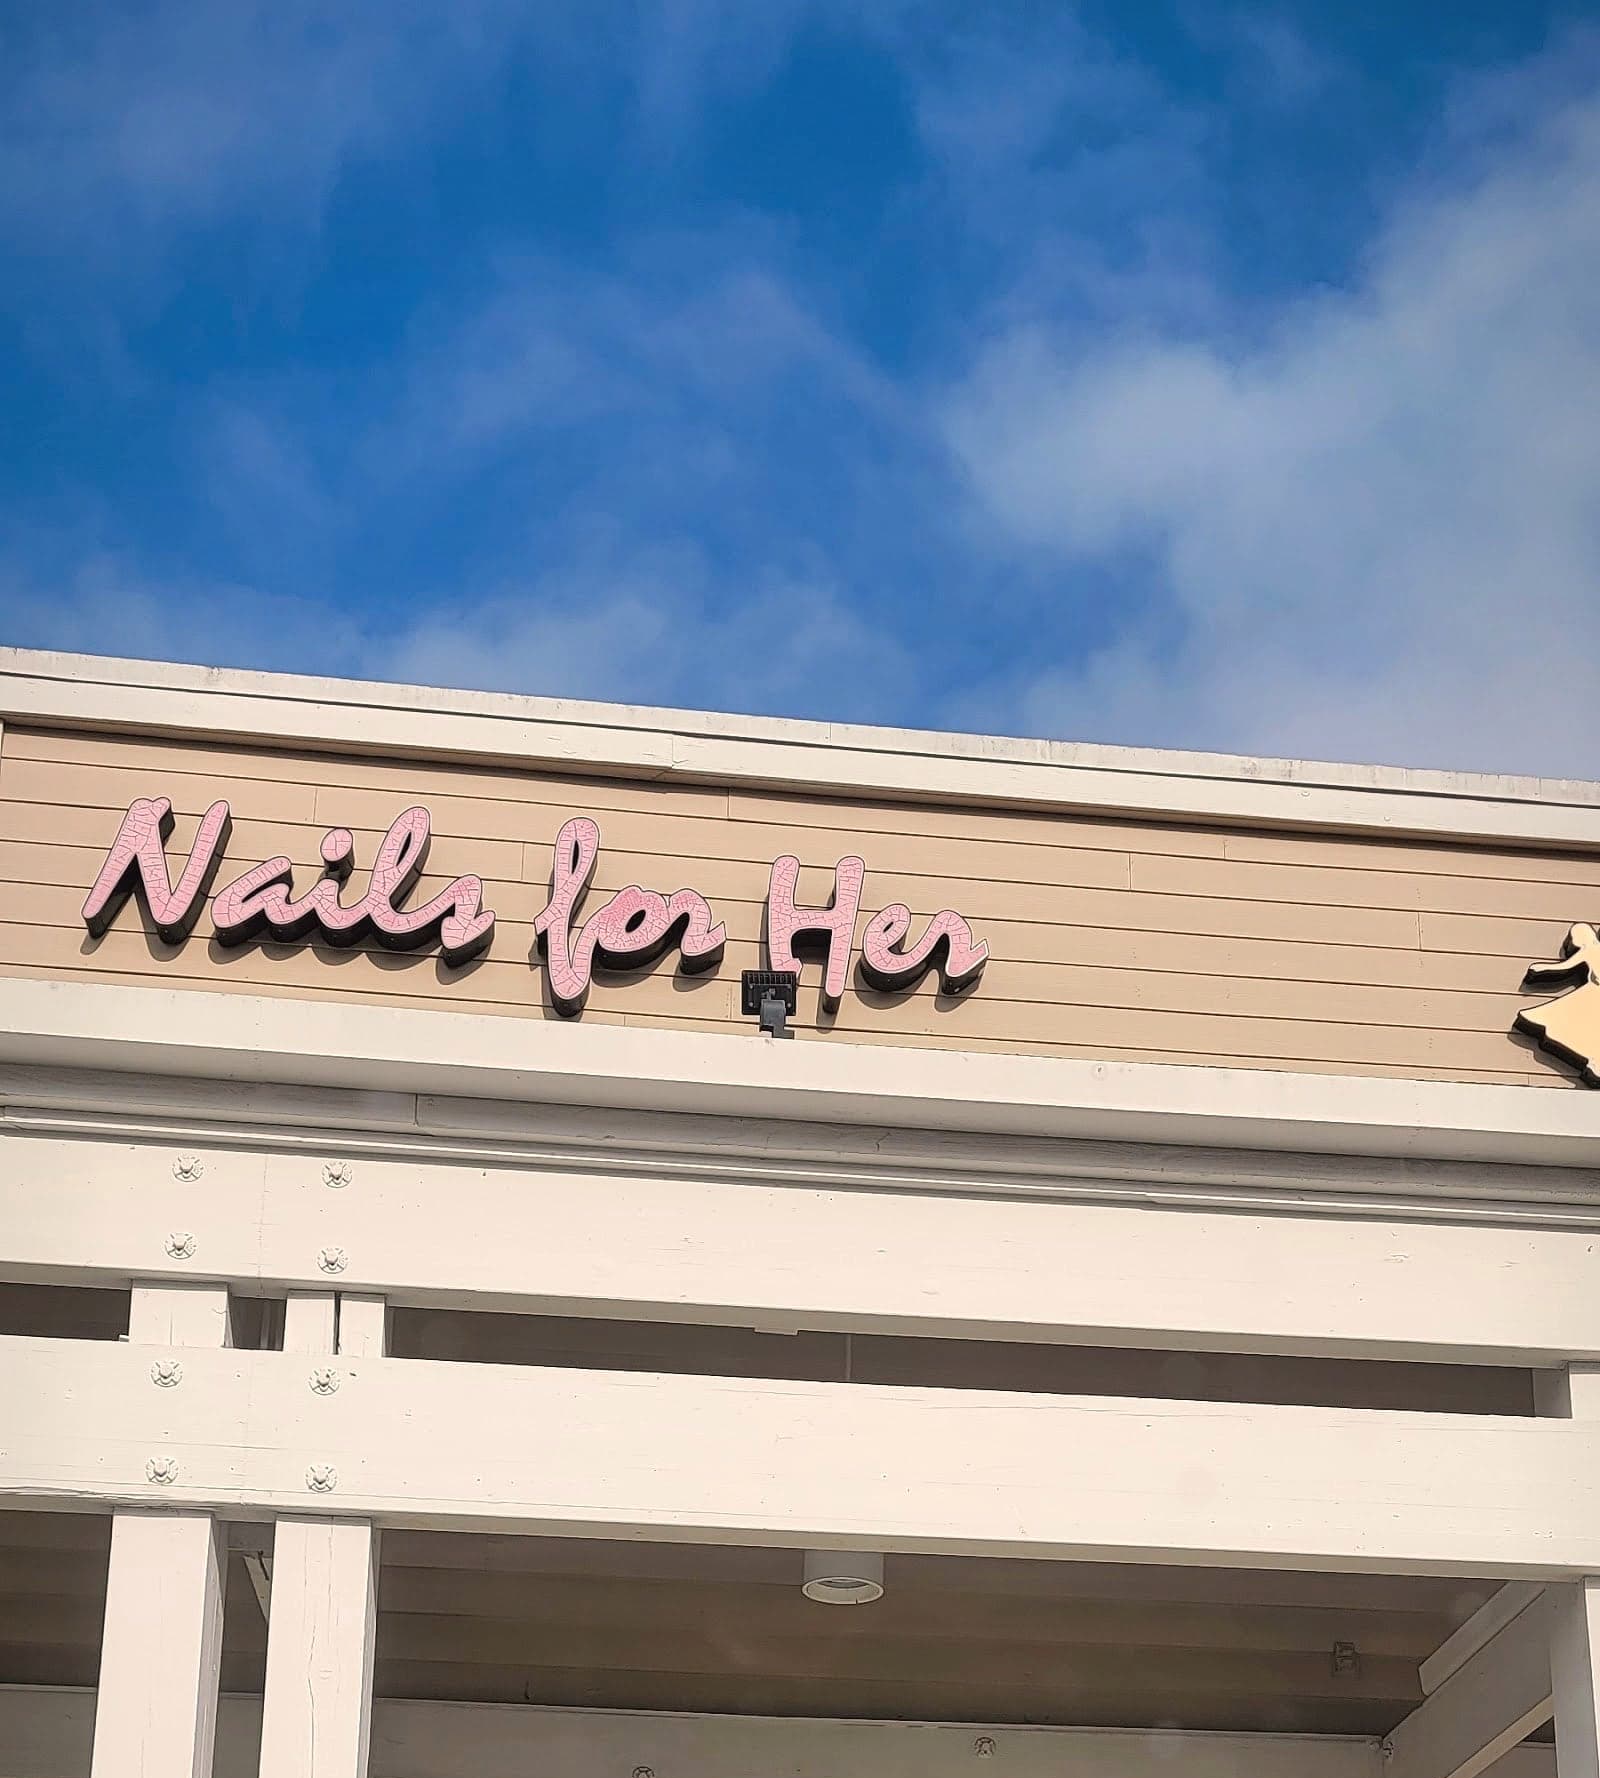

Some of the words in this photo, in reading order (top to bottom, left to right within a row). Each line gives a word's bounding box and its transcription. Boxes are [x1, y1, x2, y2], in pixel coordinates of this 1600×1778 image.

[80, 796, 496, 958] Nails
[533, 816, 727, 1004] for
[764, 853, 990, 1004] Her
